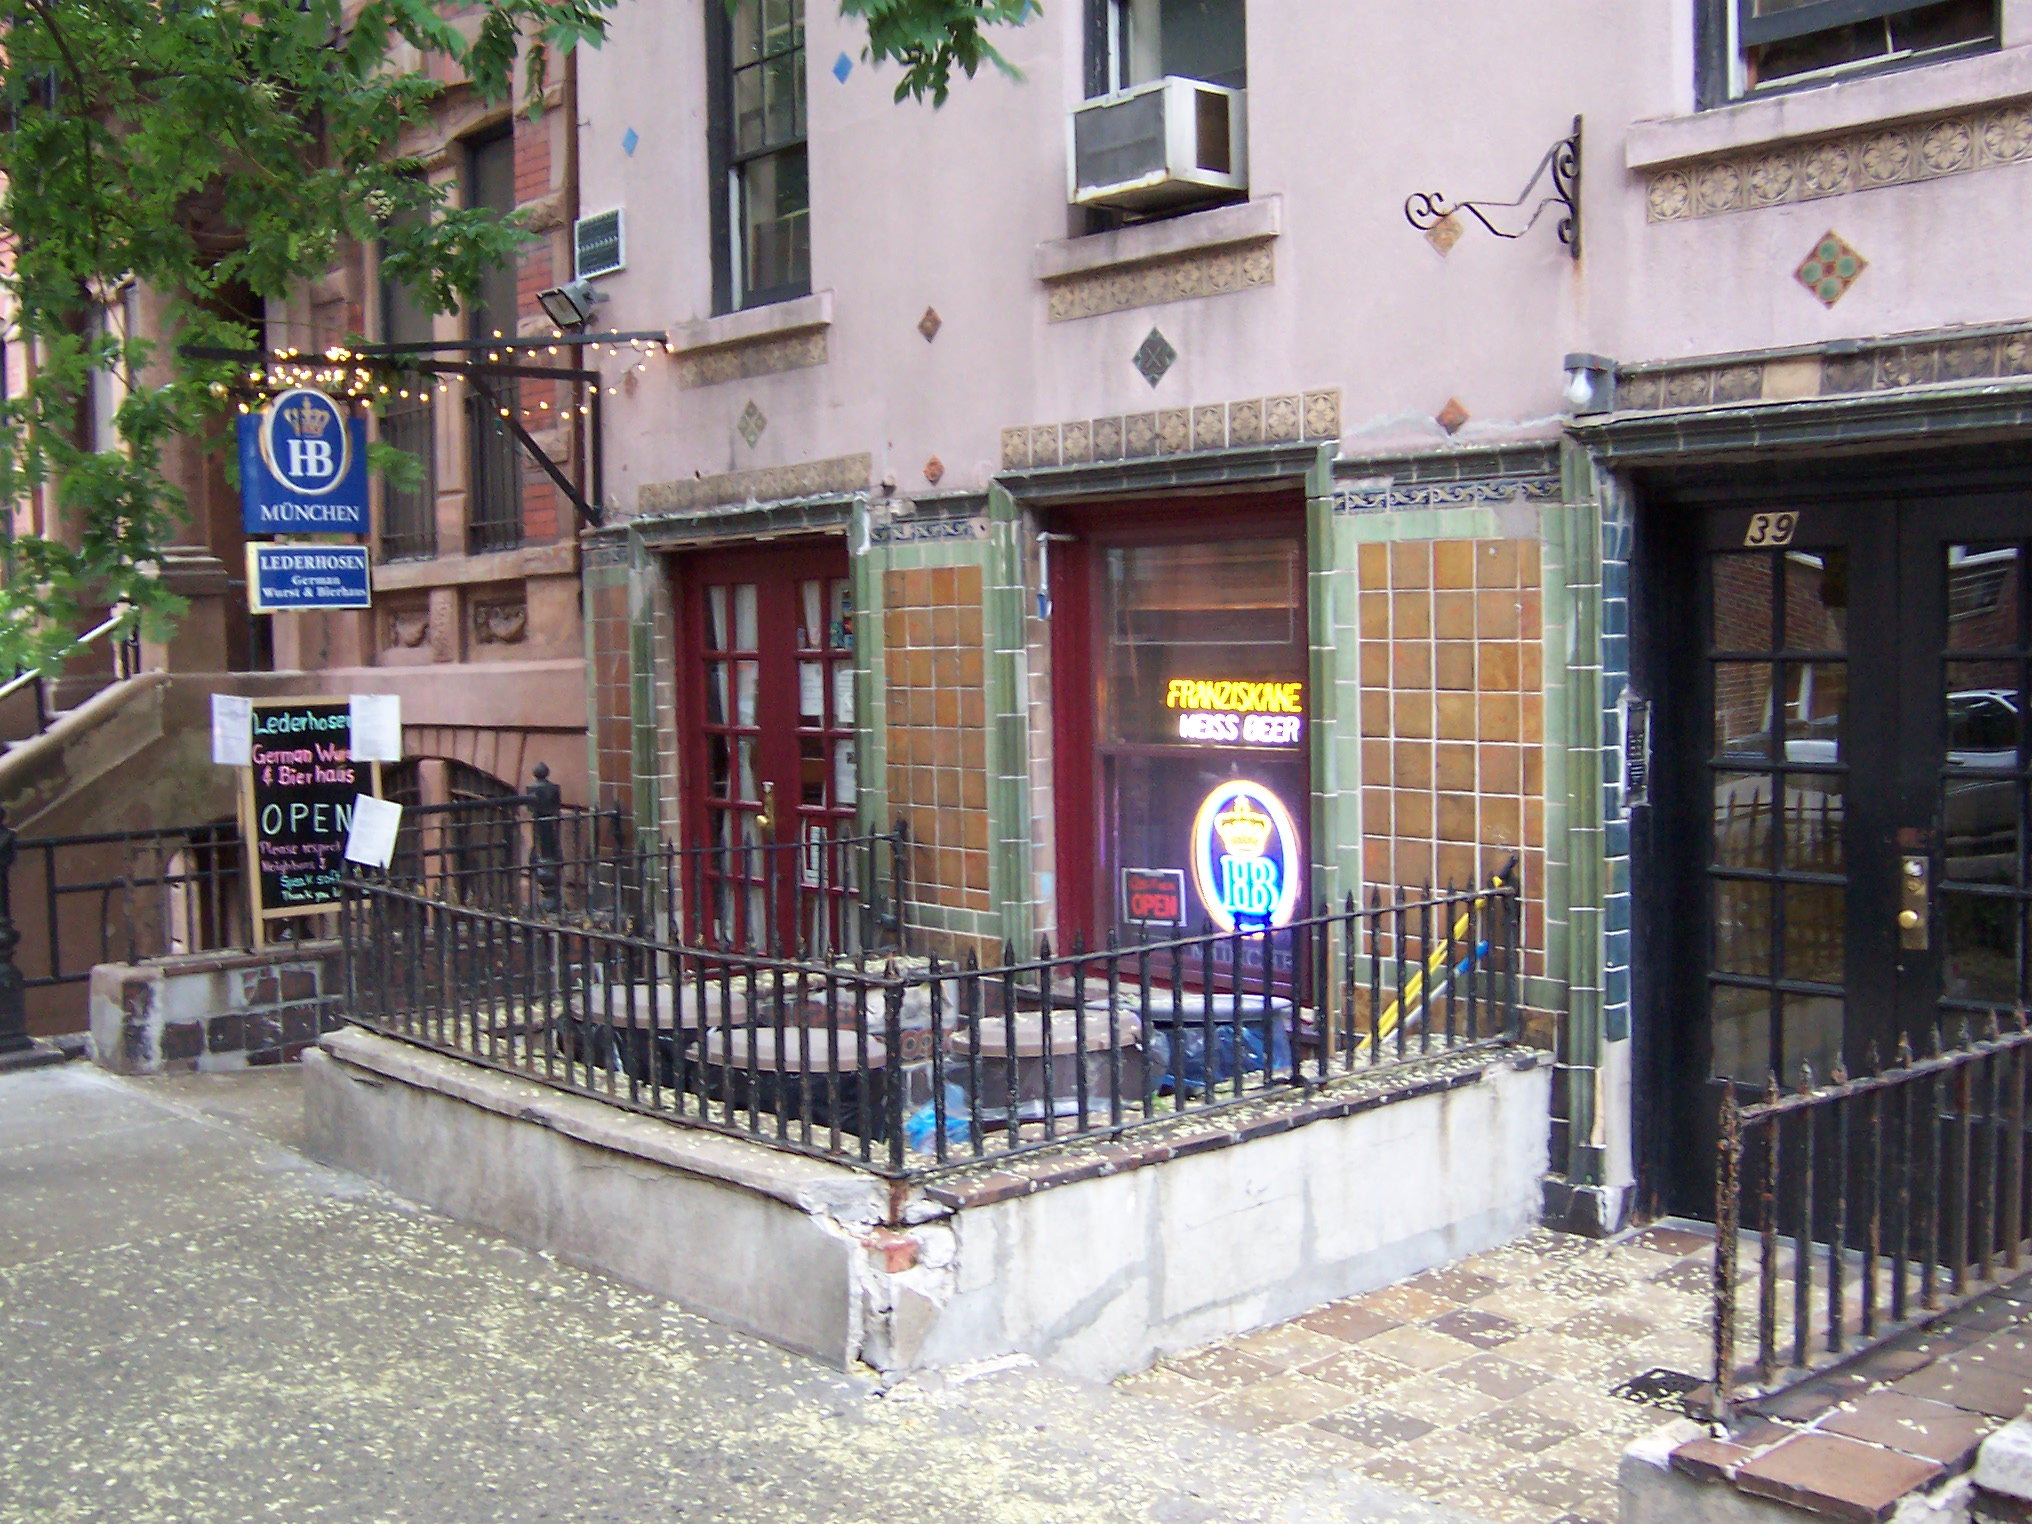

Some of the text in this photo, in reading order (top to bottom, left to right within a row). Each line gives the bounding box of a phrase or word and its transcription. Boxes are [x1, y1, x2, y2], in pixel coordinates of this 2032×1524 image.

[287, 438, 334, 478] HB
[260, 502, 360, 522] MÜNCHEN
[1749, 514, 1795, 544] 39
[261, 555, 365, 571] LEDERHOSEN
[290, 575, 341, 586] German
[302, 586, 314, 598] &
[1179, 713, 1300, 743] WEISS BEER
[252, 743, 314, 765] German
[261, 803, 351, 835] OPEN
[1131, 893, 1178, 917] OPEN
